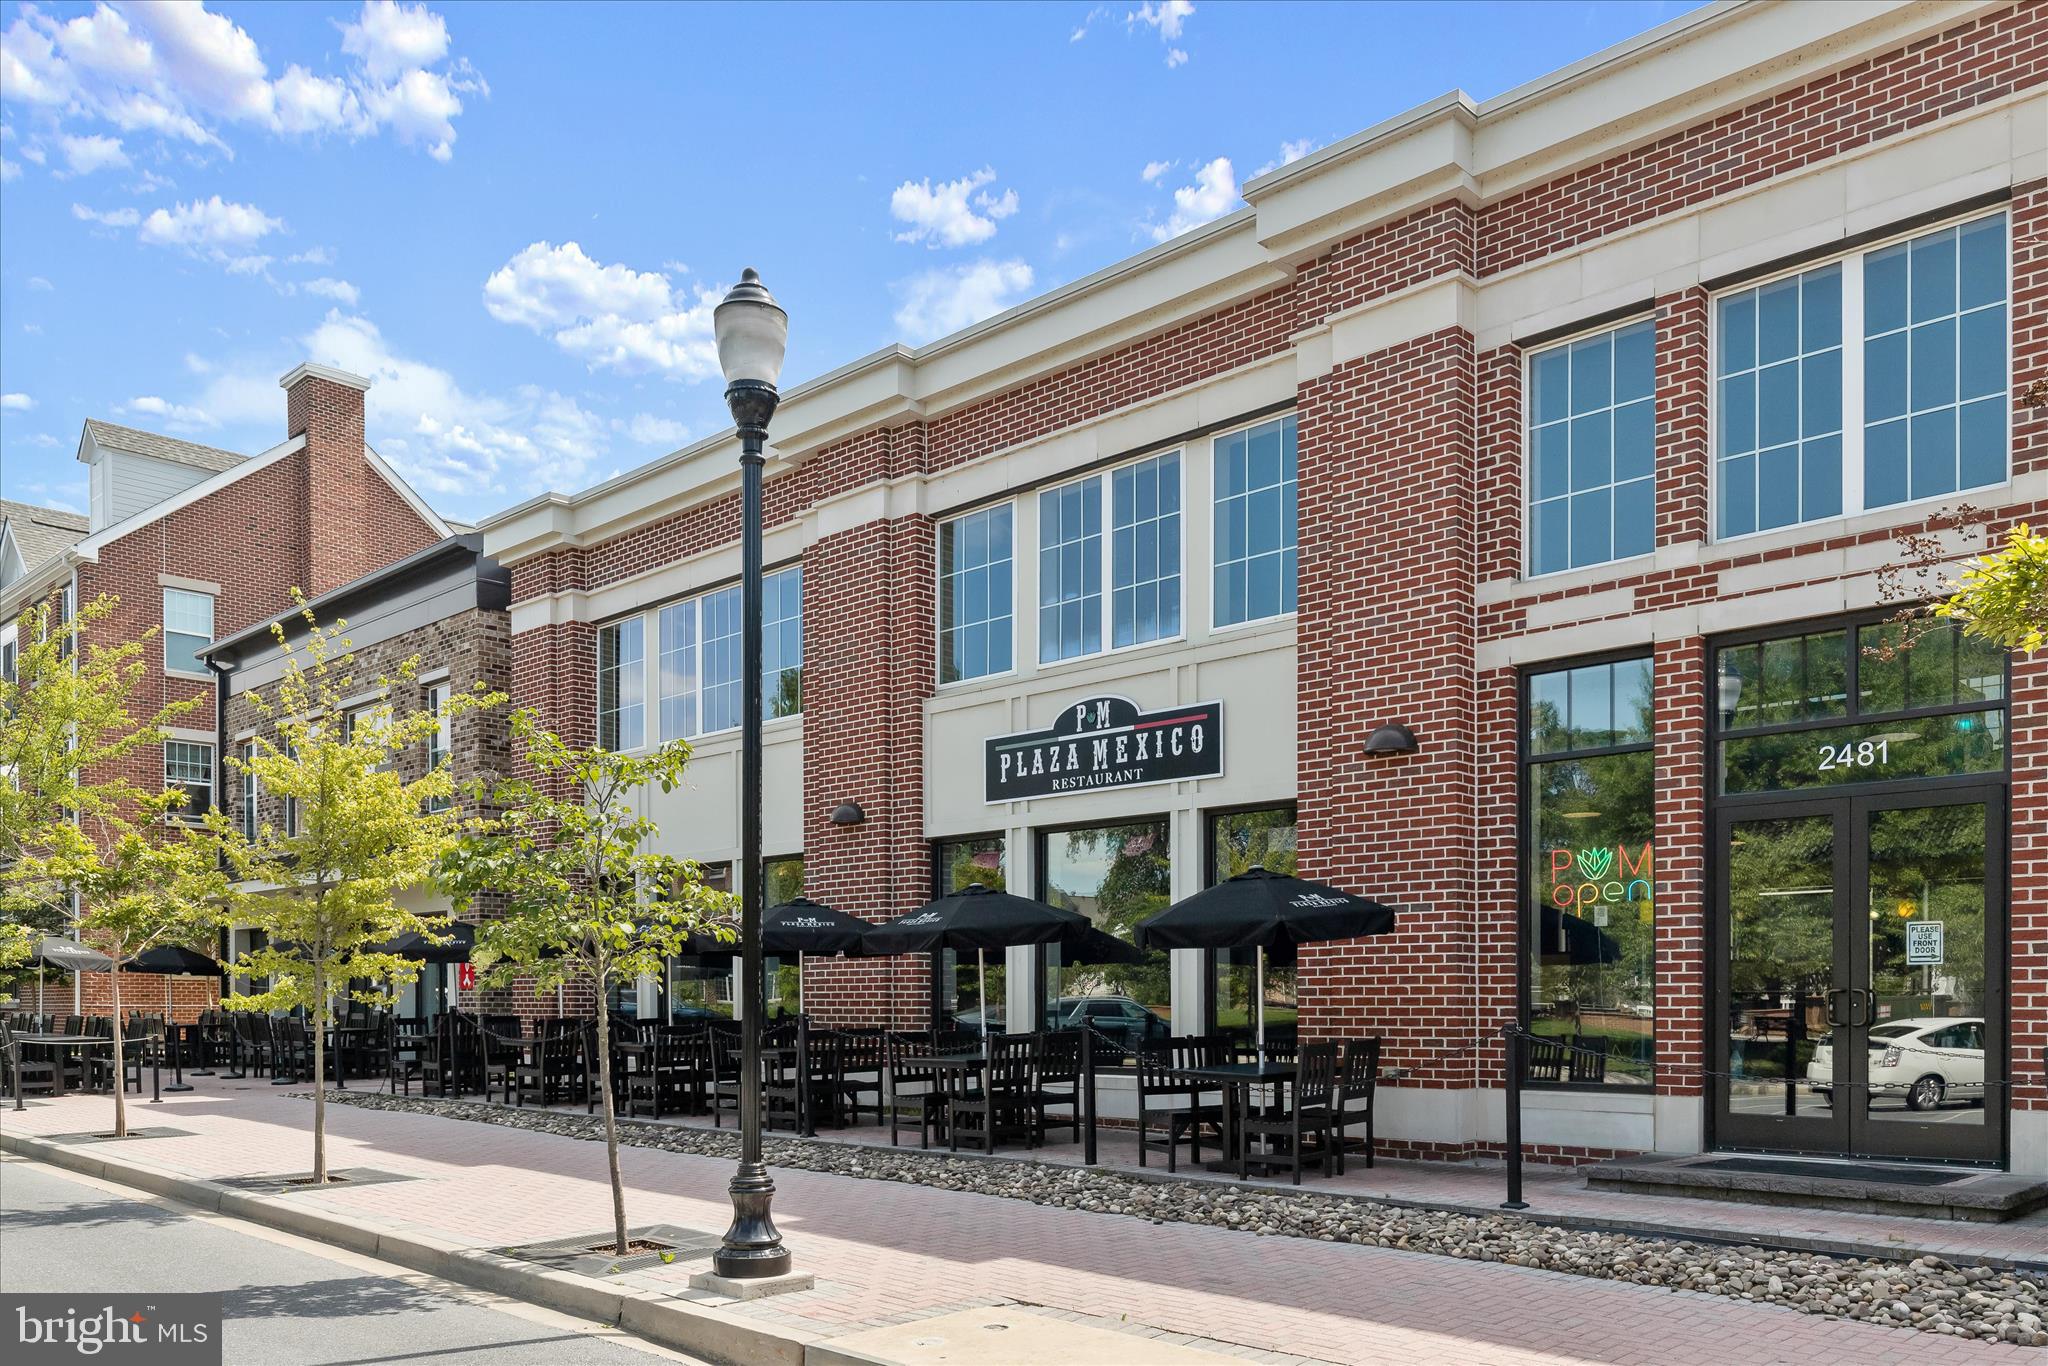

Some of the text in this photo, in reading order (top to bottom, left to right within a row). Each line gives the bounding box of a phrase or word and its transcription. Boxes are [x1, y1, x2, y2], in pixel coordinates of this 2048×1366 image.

[1076, 700, 1111, 733] P M
[1000, 724, 1205, 784] PLAZA MEXICO
[1818, 740, 1888, 771] 2481
[1052, 768, 1144, 791] RESTAURANT
[1551, 841, 1652, 885] P M
[1552, 879, 1652, 919] open
